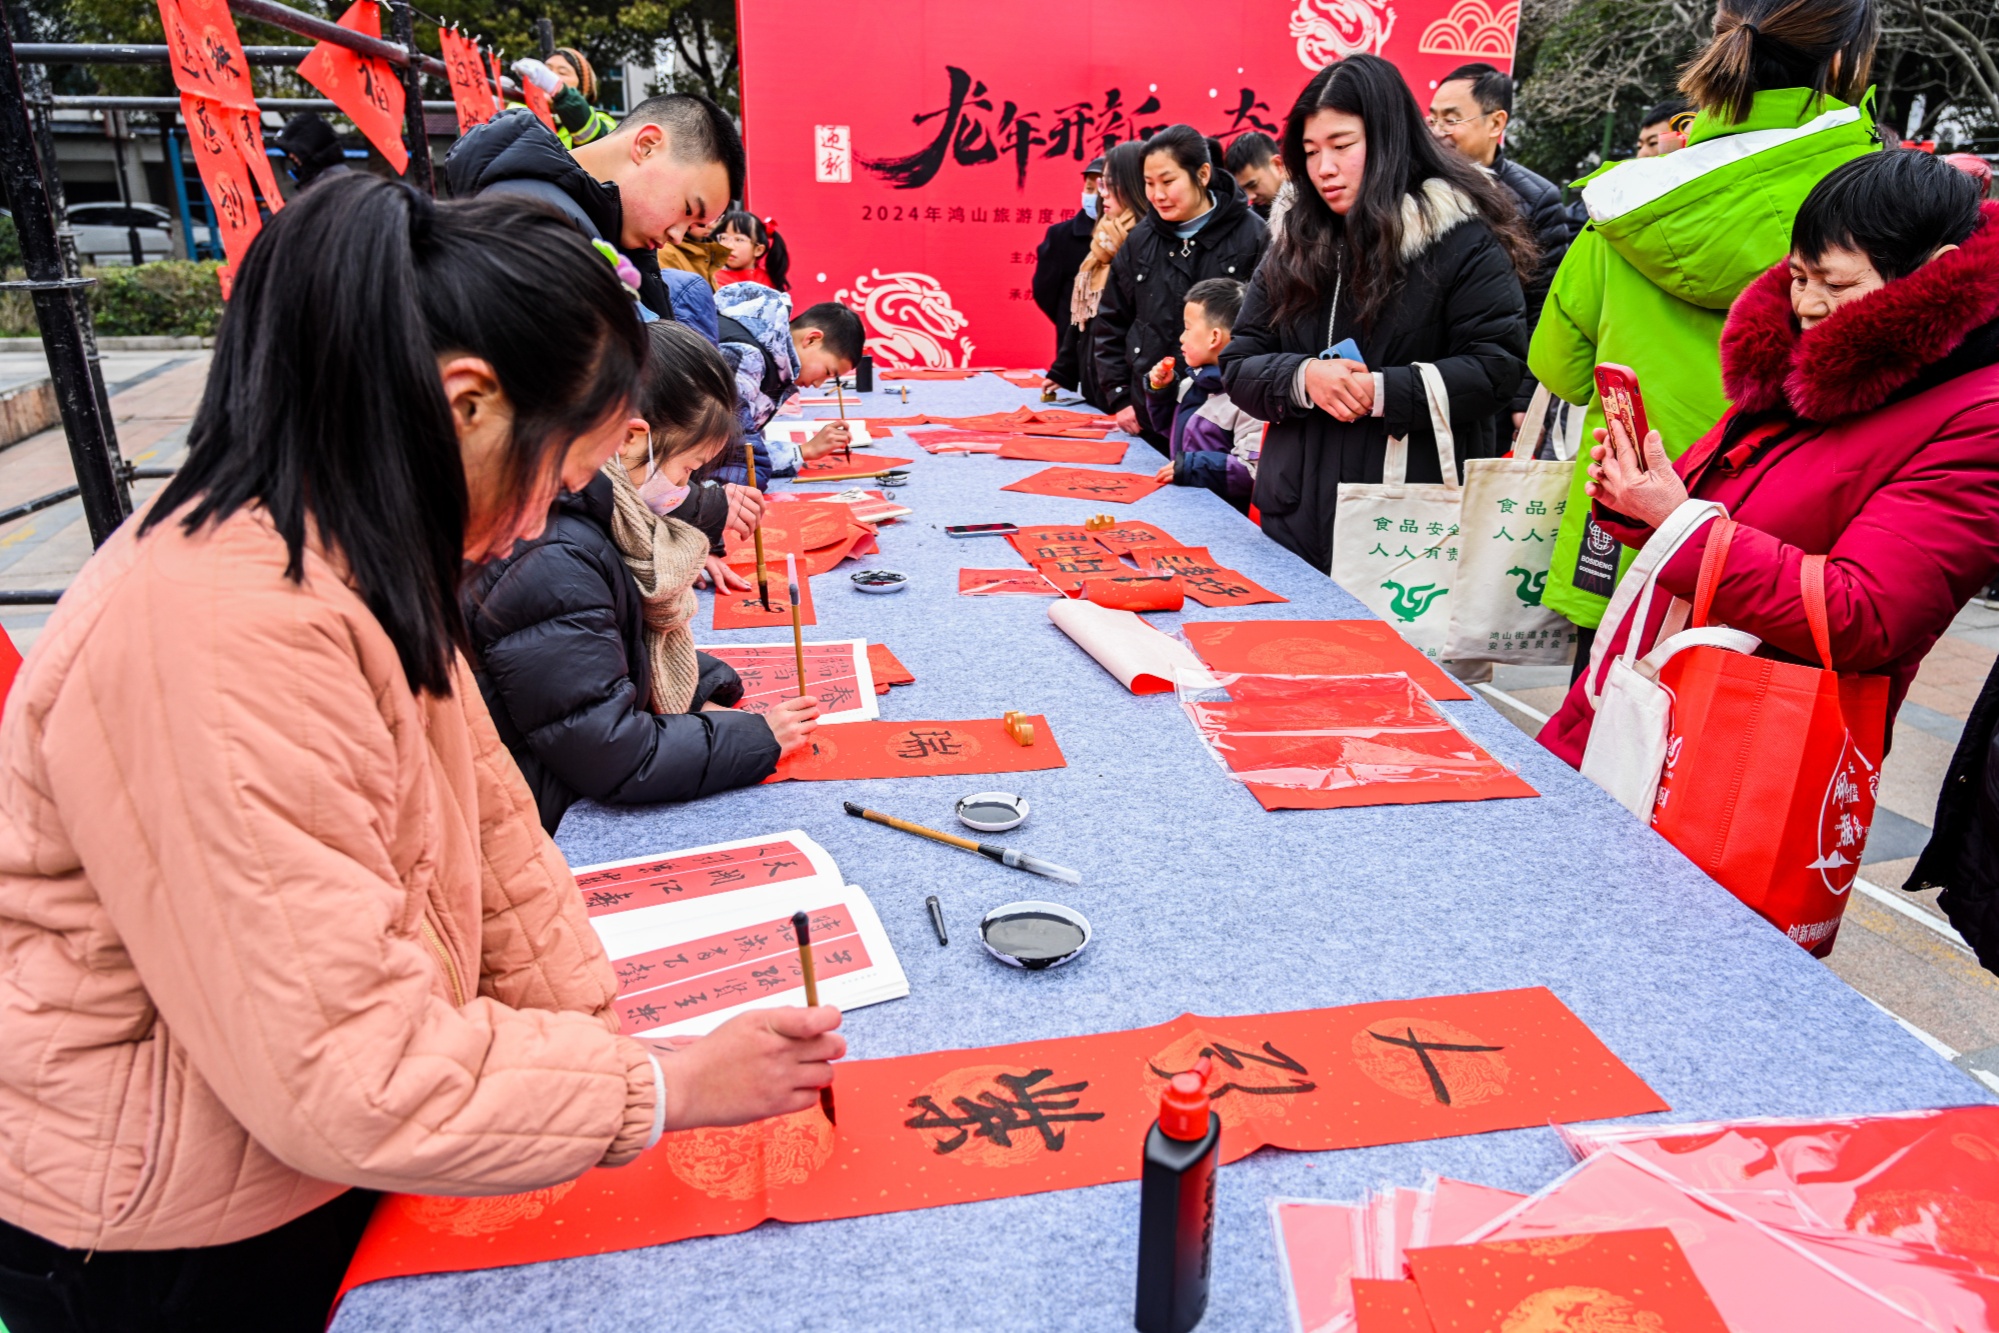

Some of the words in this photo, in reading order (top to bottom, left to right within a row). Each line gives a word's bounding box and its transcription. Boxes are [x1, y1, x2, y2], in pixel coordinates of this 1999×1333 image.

[1372, 516, 1460, 537] 食品安全
[1368, 542, 1459, 562] 人人有责
[1580, 554, 1613, 571] BOSIDENG
[1487, 639, 1561, 651] 安全委员会
